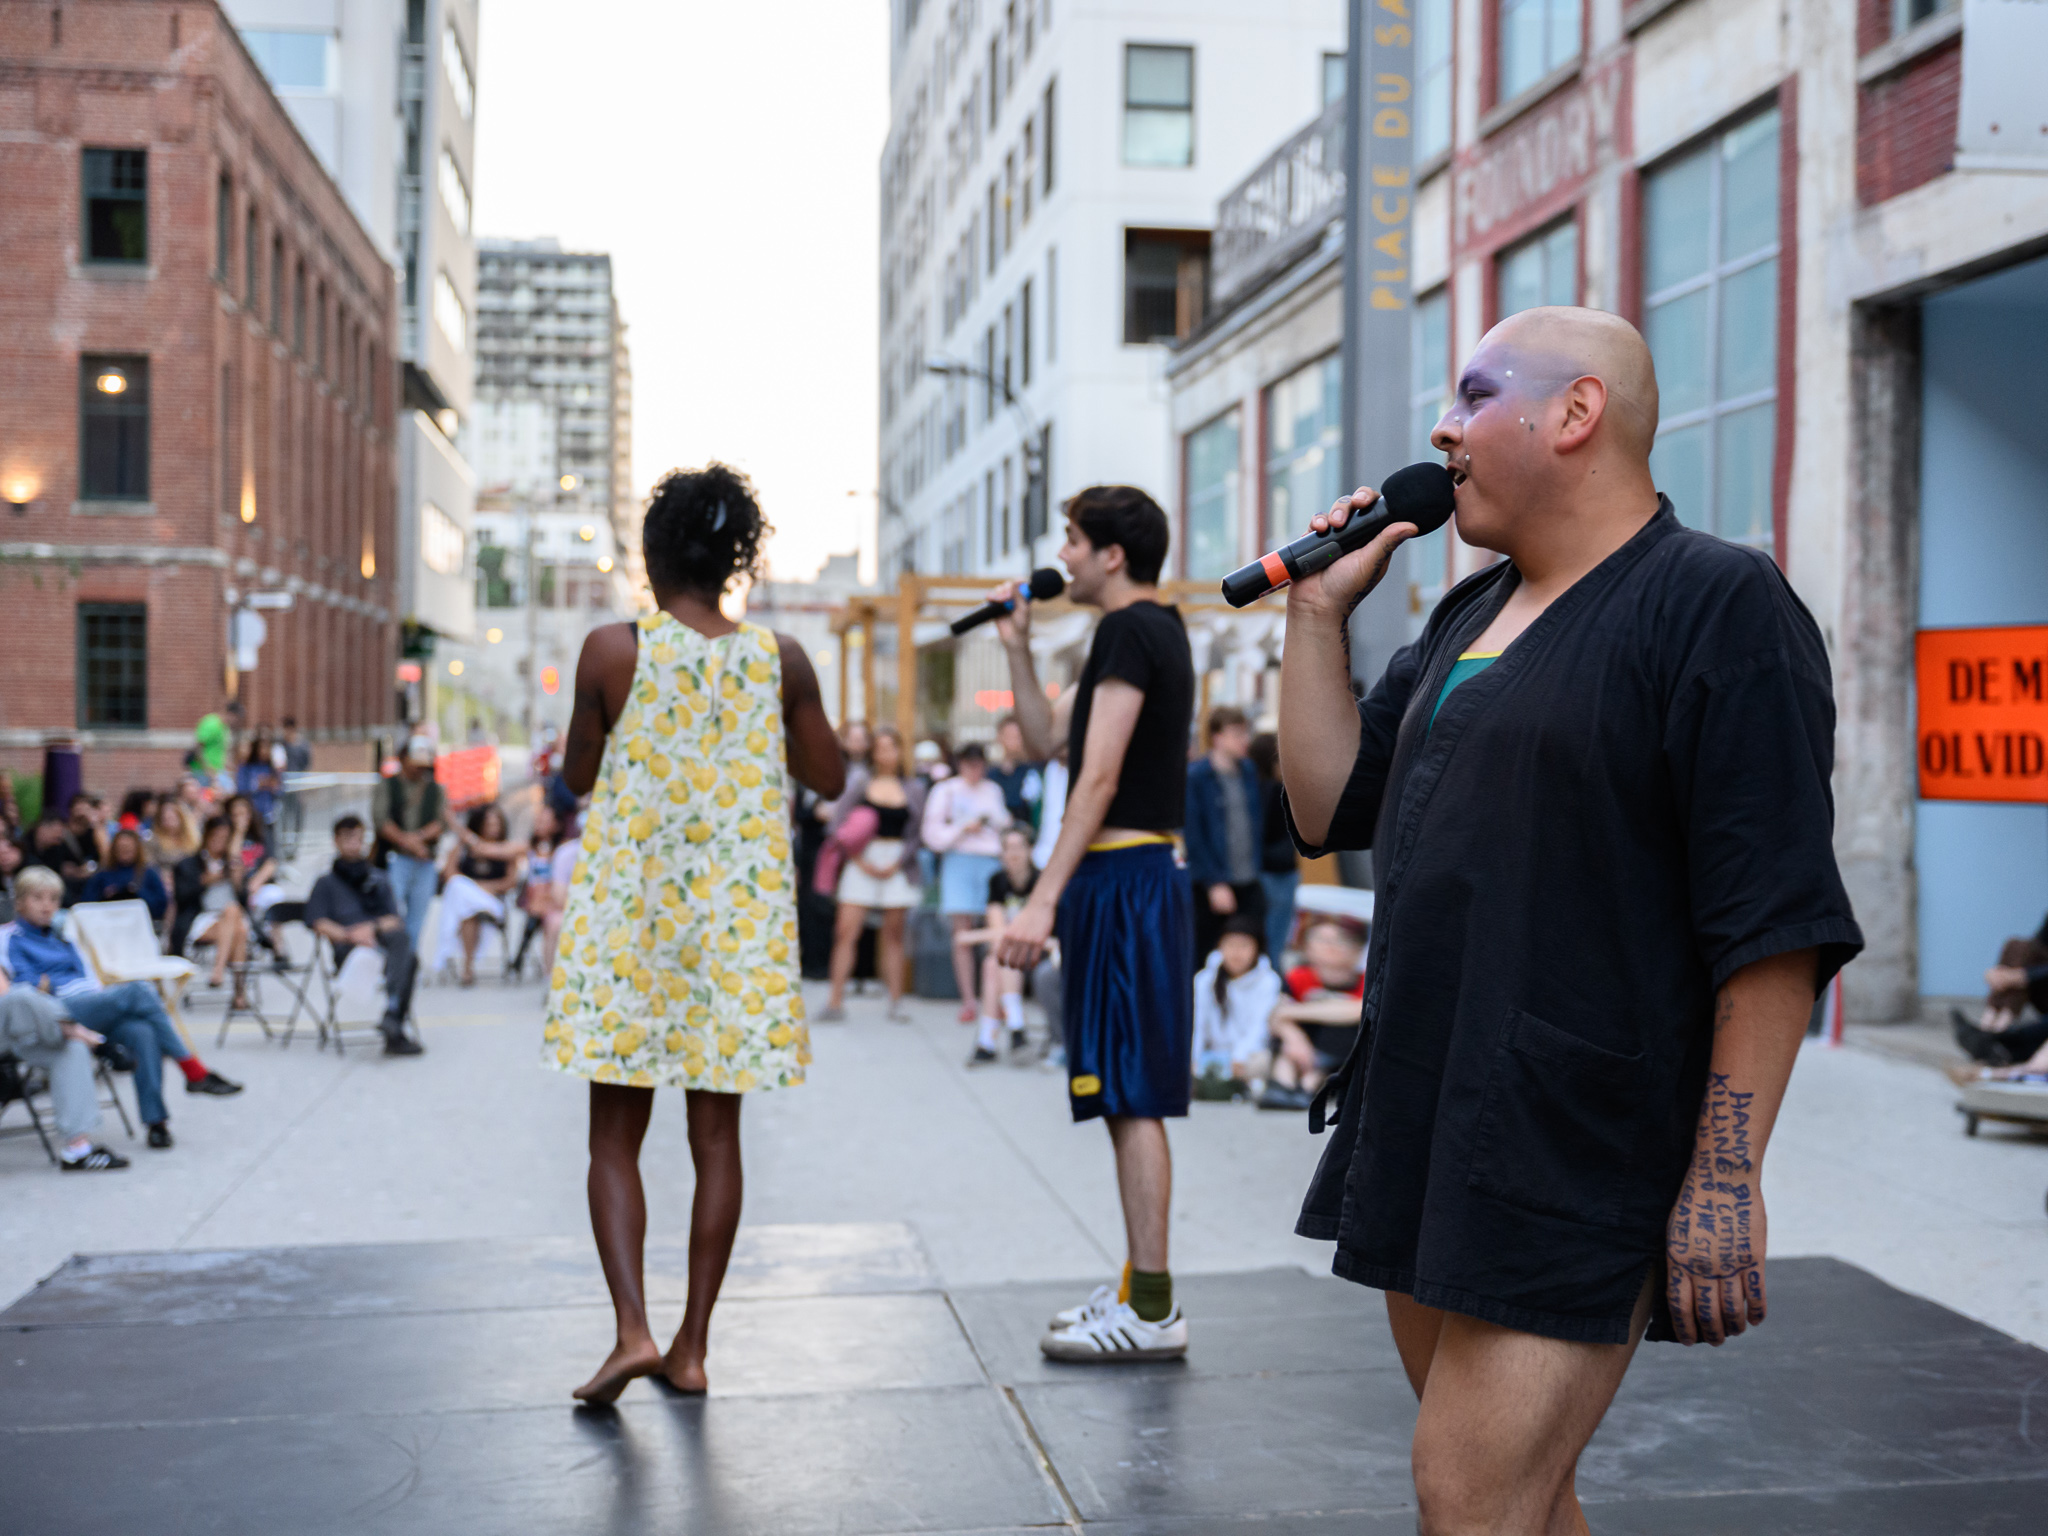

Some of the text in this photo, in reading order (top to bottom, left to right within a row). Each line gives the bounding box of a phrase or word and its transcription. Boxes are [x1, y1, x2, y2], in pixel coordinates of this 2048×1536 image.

[1372, 73, 1412, 138] DU
[1370, 165, 1410, 310] PLACE
[1948, 657, 2000, 705] DE
[1922, 730, 2045, 777] OLVID
[1711, 1072, 1734, 1175] KILLING
[1728, 1091, 1755, 1174] HANDS
[1695, 1199, 1717, 1237] THE
[1716, 1204, 1736, 1272] CUTTING
